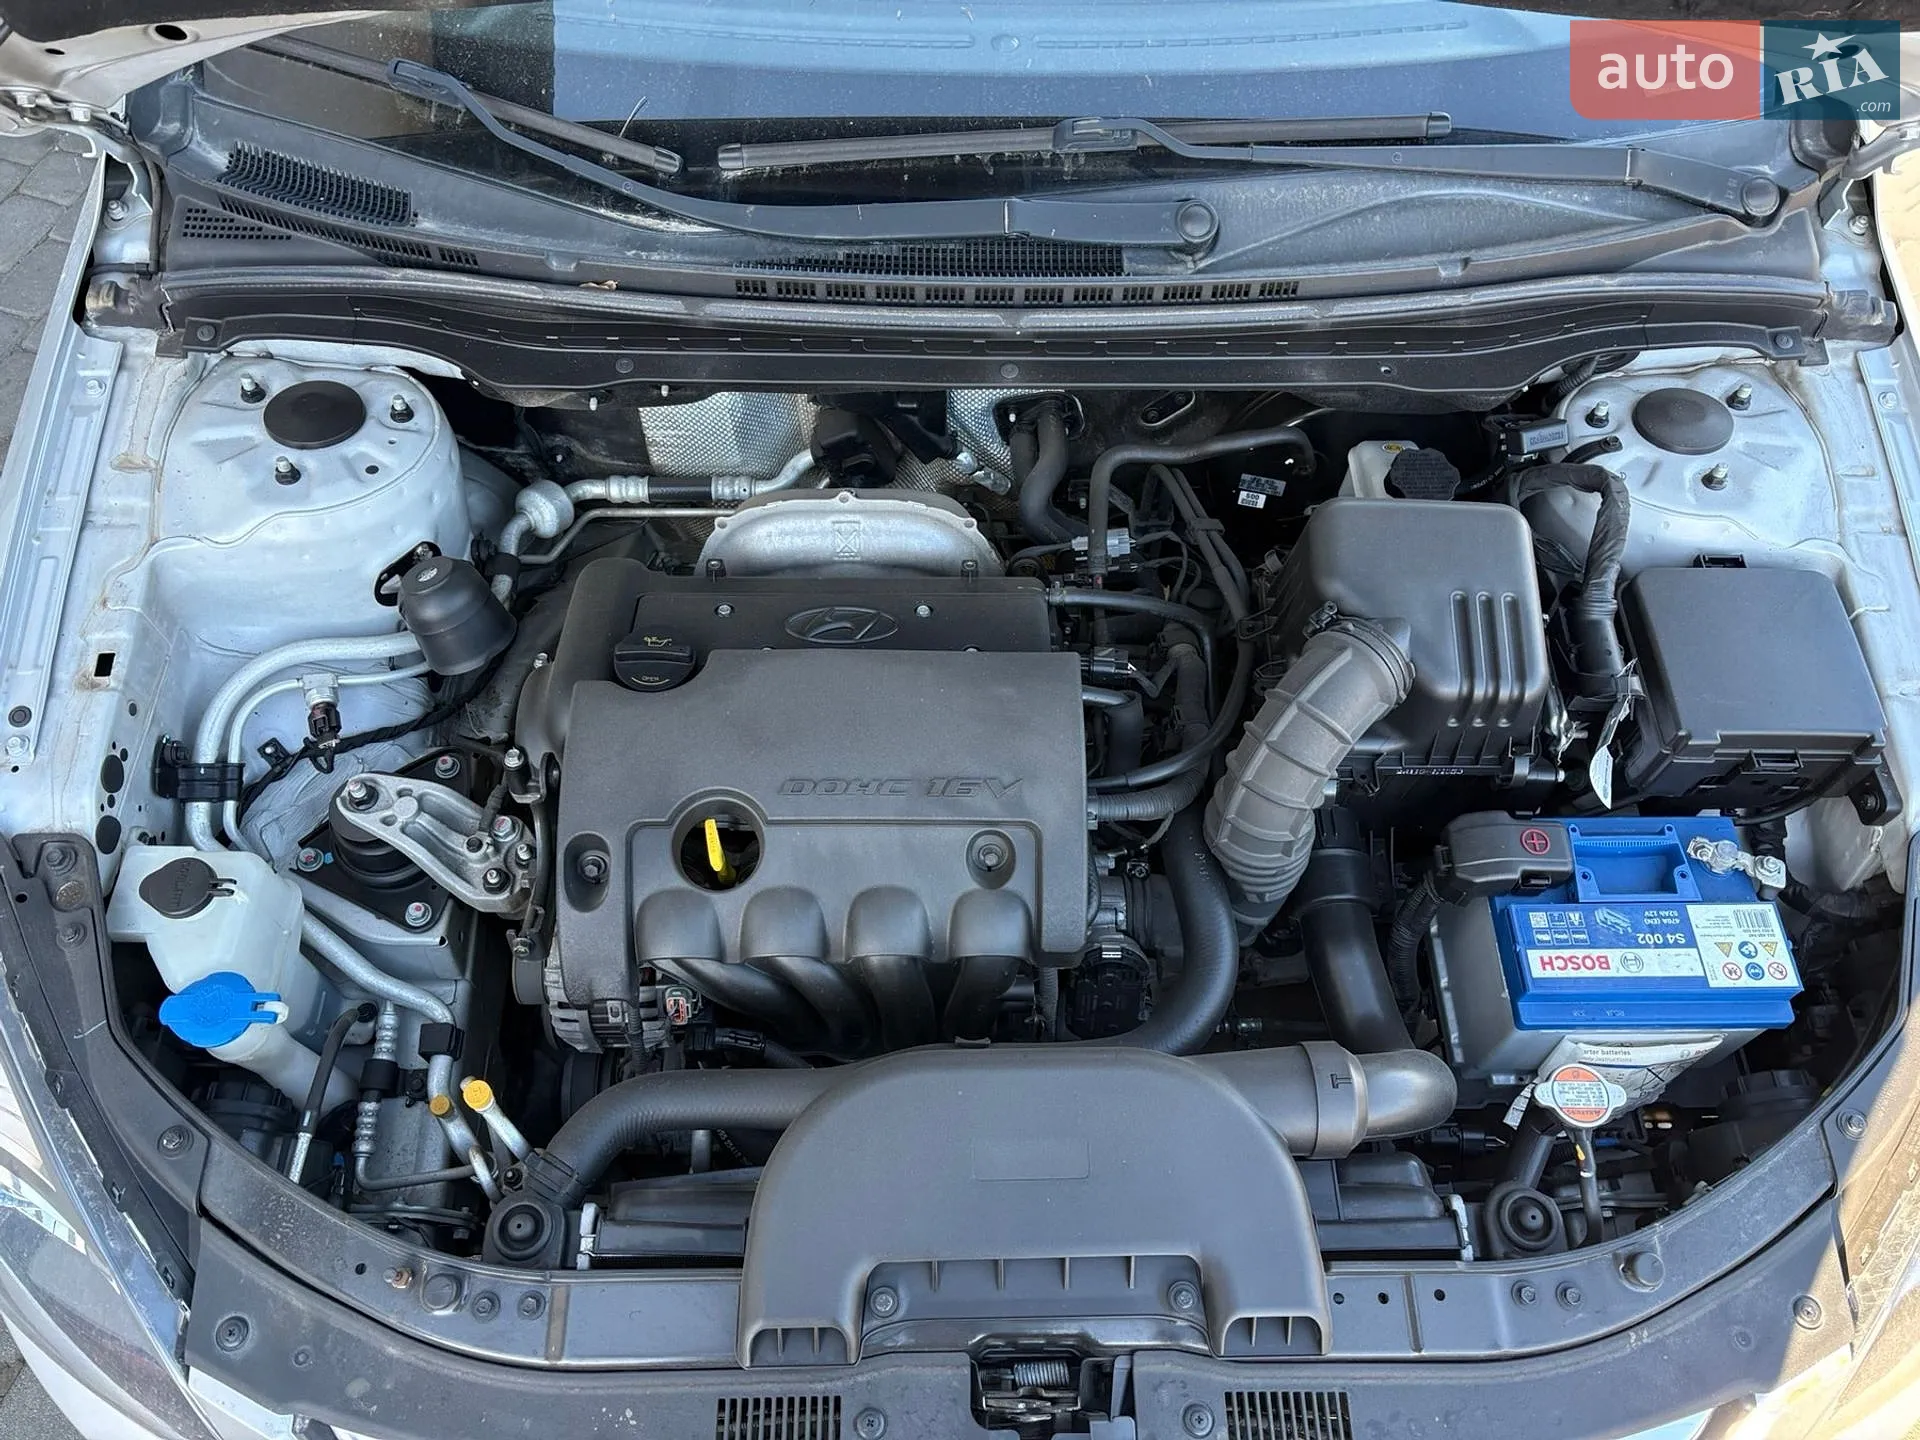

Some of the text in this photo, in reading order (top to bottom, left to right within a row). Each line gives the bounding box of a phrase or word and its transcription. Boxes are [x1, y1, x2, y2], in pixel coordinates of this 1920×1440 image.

[778, 777, 1023, 798] DOHC 16V
[1636, 933, 1664, 944] 002
[1665, 933, 1686, 944] S4
[1539, 955, 1611, 972] BOSCH
[1600, 1048, 1632, 1056] batteries
